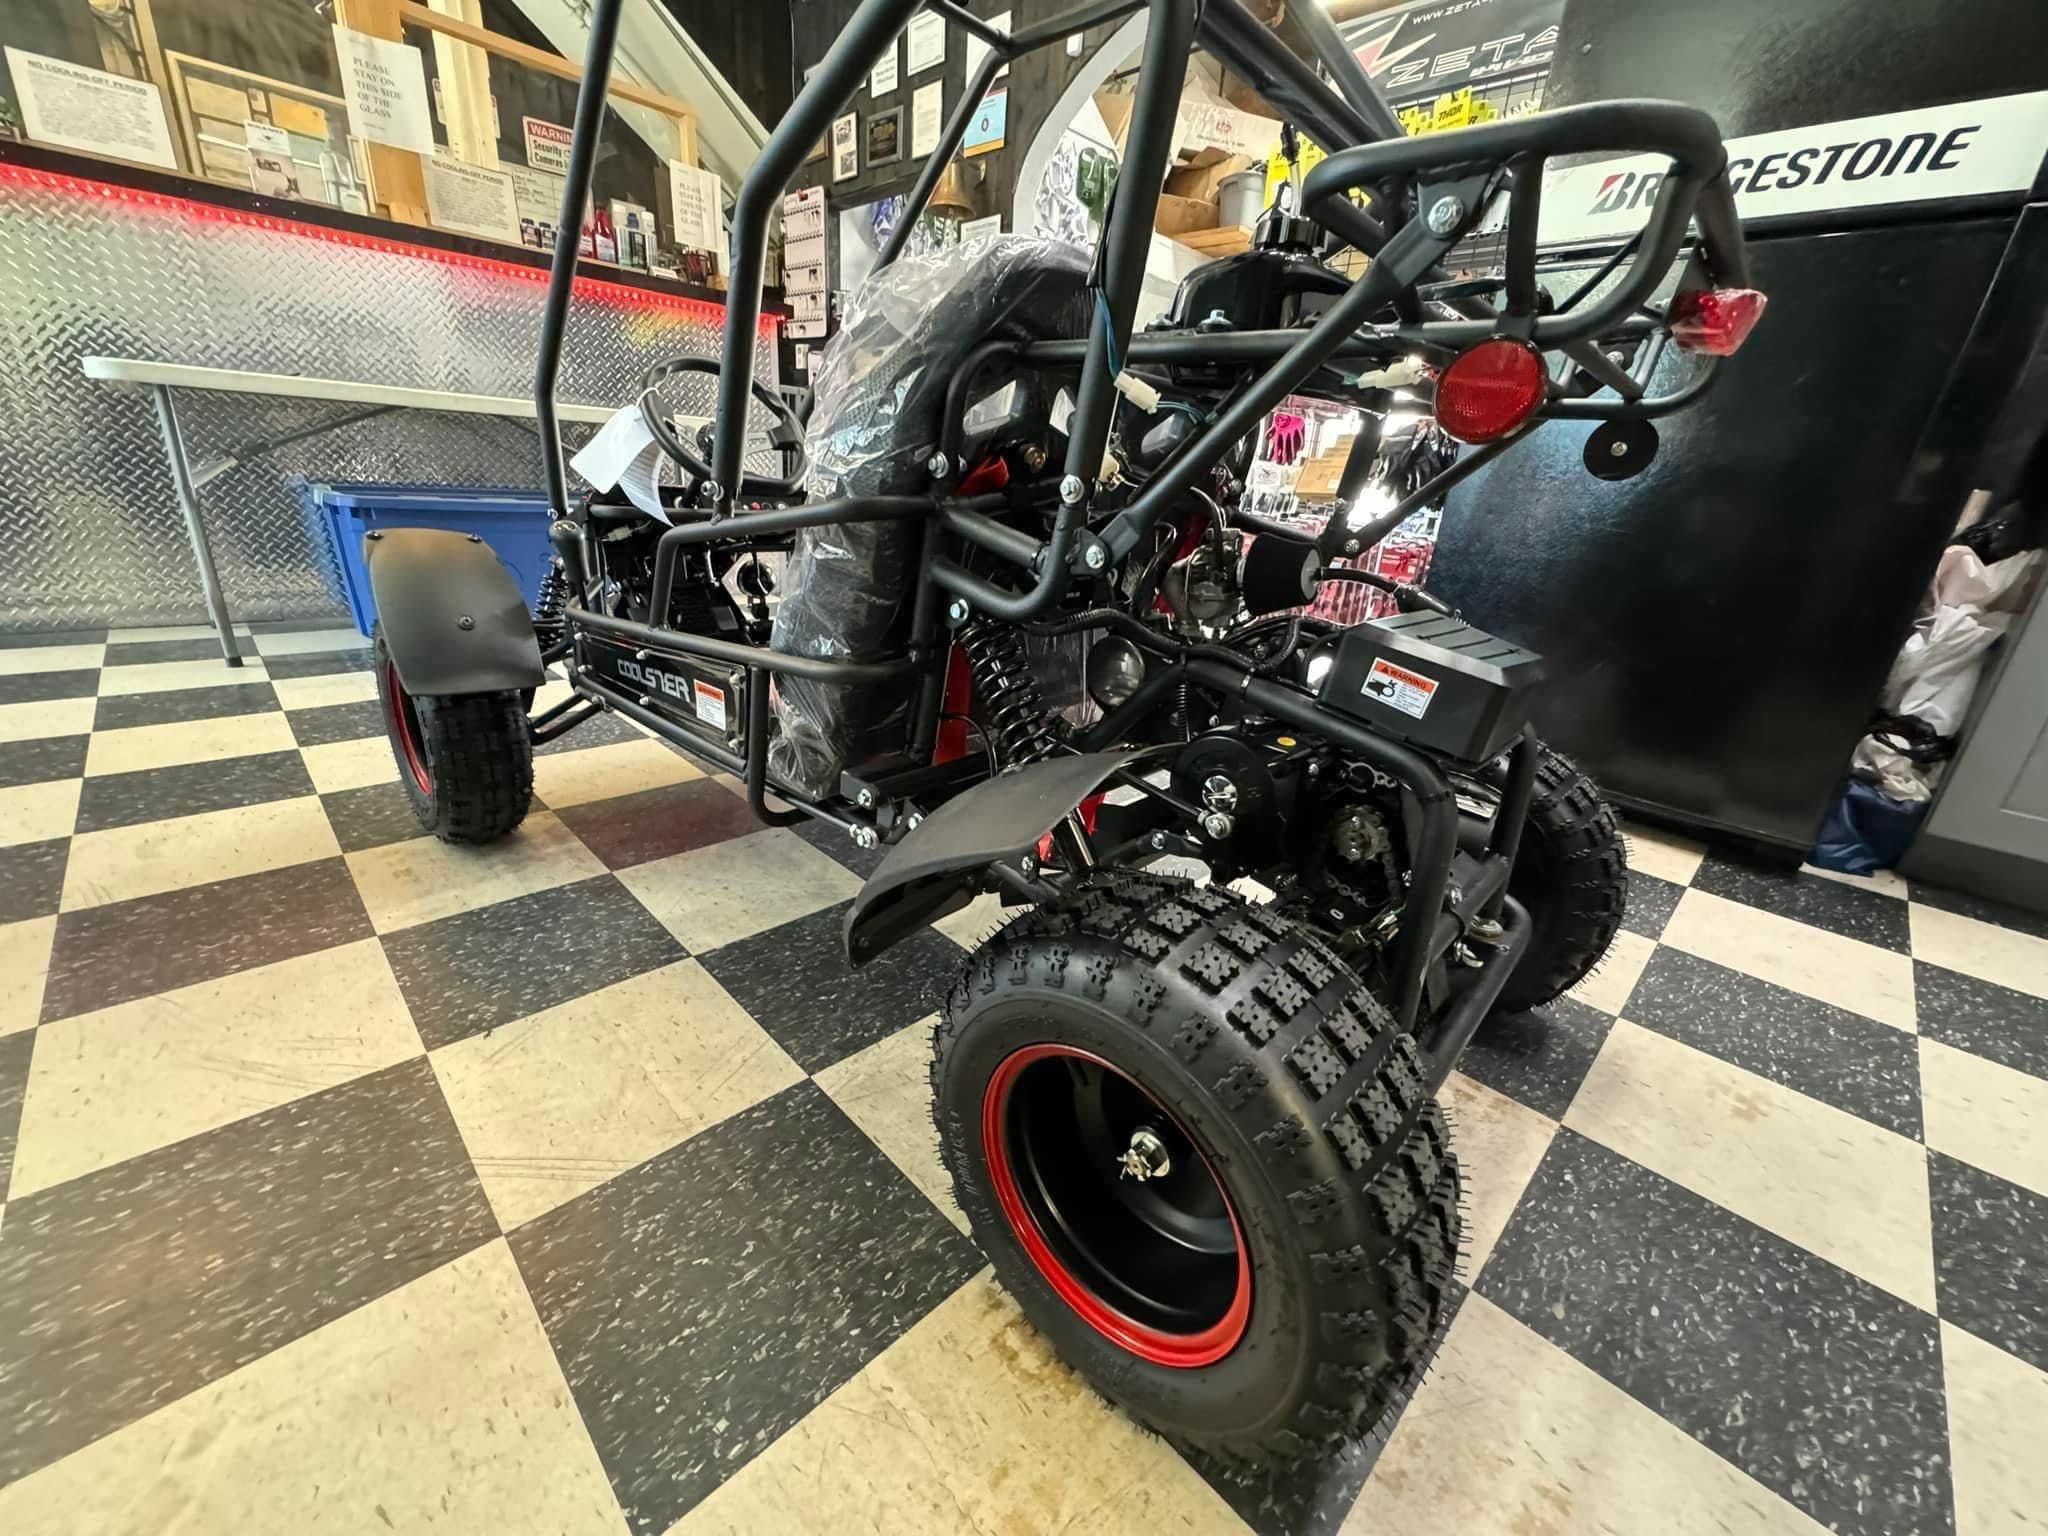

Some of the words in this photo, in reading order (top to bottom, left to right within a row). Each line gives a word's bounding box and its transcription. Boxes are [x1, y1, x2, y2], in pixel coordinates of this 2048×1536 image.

[353, 57, 390, 75] PLEASE
[1386, 26, 1560, 89] ZETA
[353, 67, 377, 82] STAY
[380, 76, 396, 88] ON
[356, 80, 379, 94] THIS
[380, 87, 402, 100] SIDE
[357, 91, 370, 101] OF
[374, 96, 390, 108] THE
[359, 103, 392, 119] GLASS
[1438, 104, 1464, 122] THOR
[533, 139, 562, 158] Security
[534, 151, 563, 168] Cameras
[1587, 125, 1982, 216] BRGESTONE
[617, 658, 691, 703] COOLSTER
[1390, 670, 1427, 689] WARNING
